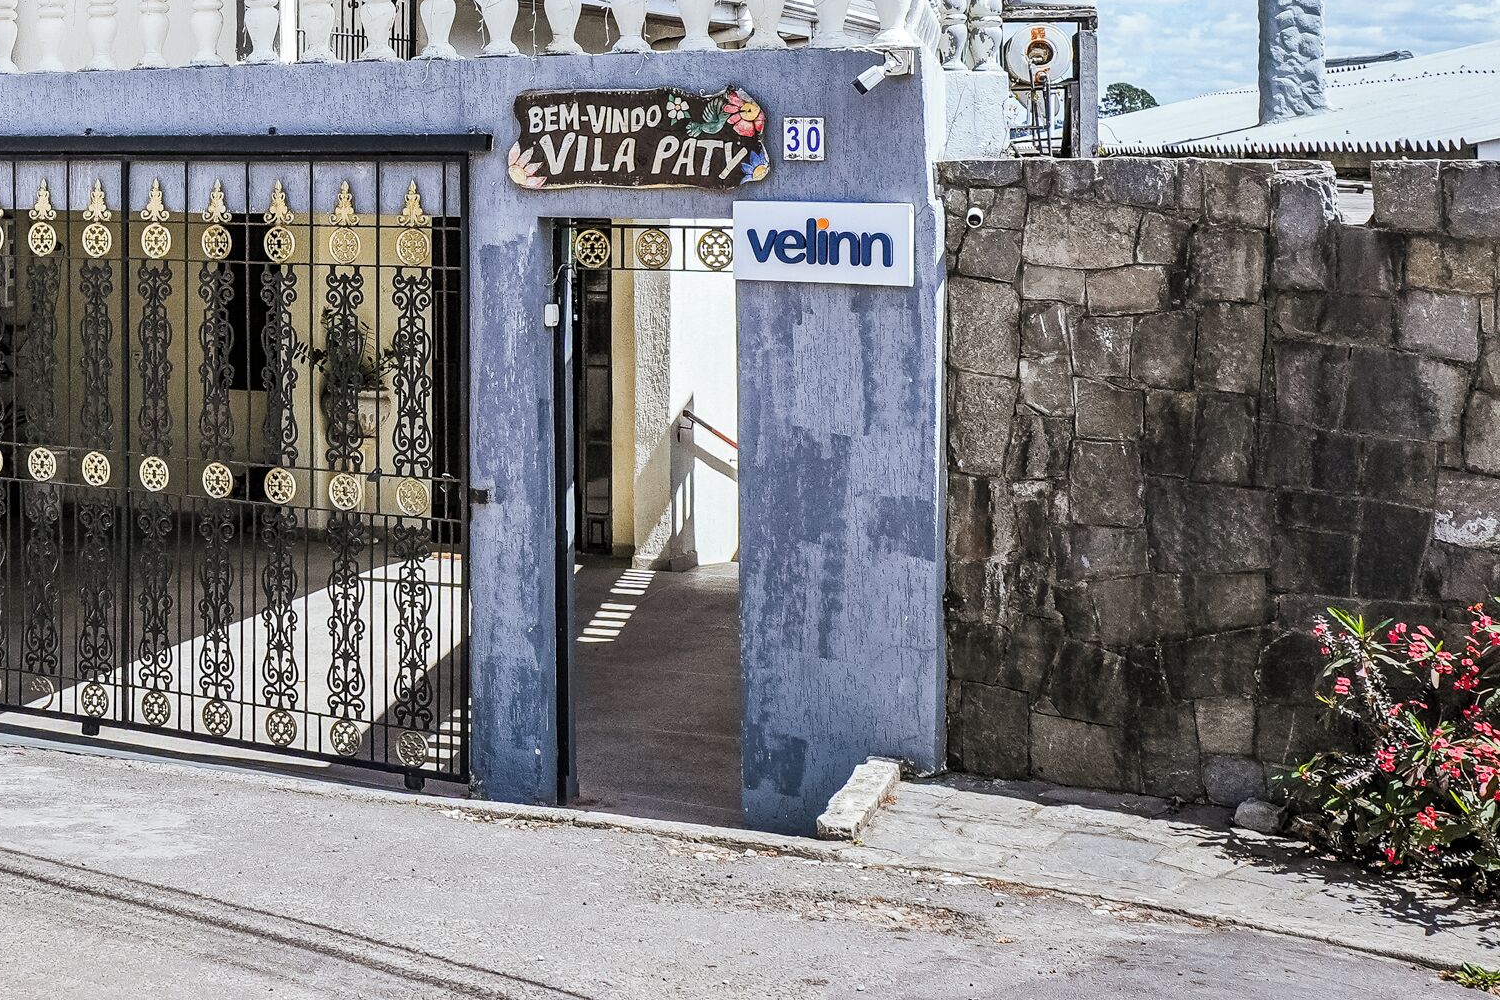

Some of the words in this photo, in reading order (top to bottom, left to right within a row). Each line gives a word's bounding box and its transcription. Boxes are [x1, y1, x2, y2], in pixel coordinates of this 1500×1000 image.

[527, 103, 662, 134] BEM-VINDO
[539, 131, 637, 177] VILA
[650, 135, 749, 180] PATY
[786, 127, 822, 153] 30
[746, 217, 894, 268] velinn
